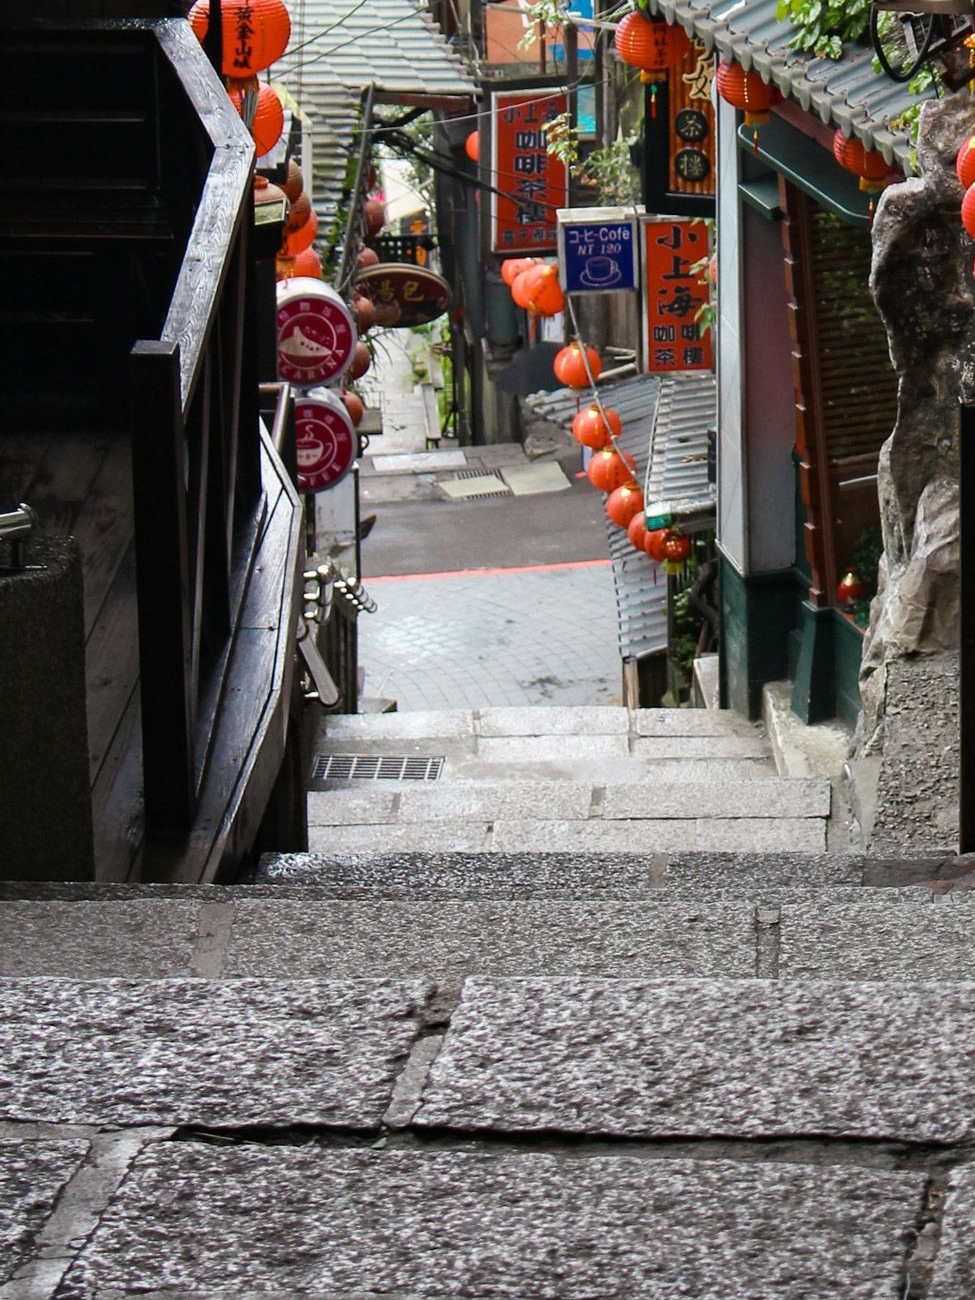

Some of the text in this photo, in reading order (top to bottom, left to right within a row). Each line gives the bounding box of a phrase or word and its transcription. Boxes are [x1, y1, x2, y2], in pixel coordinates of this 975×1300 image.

[577, 243, 622, 256] NT 120
[656, 225, 703, 318] 小上海
[281, 348, 345, 380] CARINA
